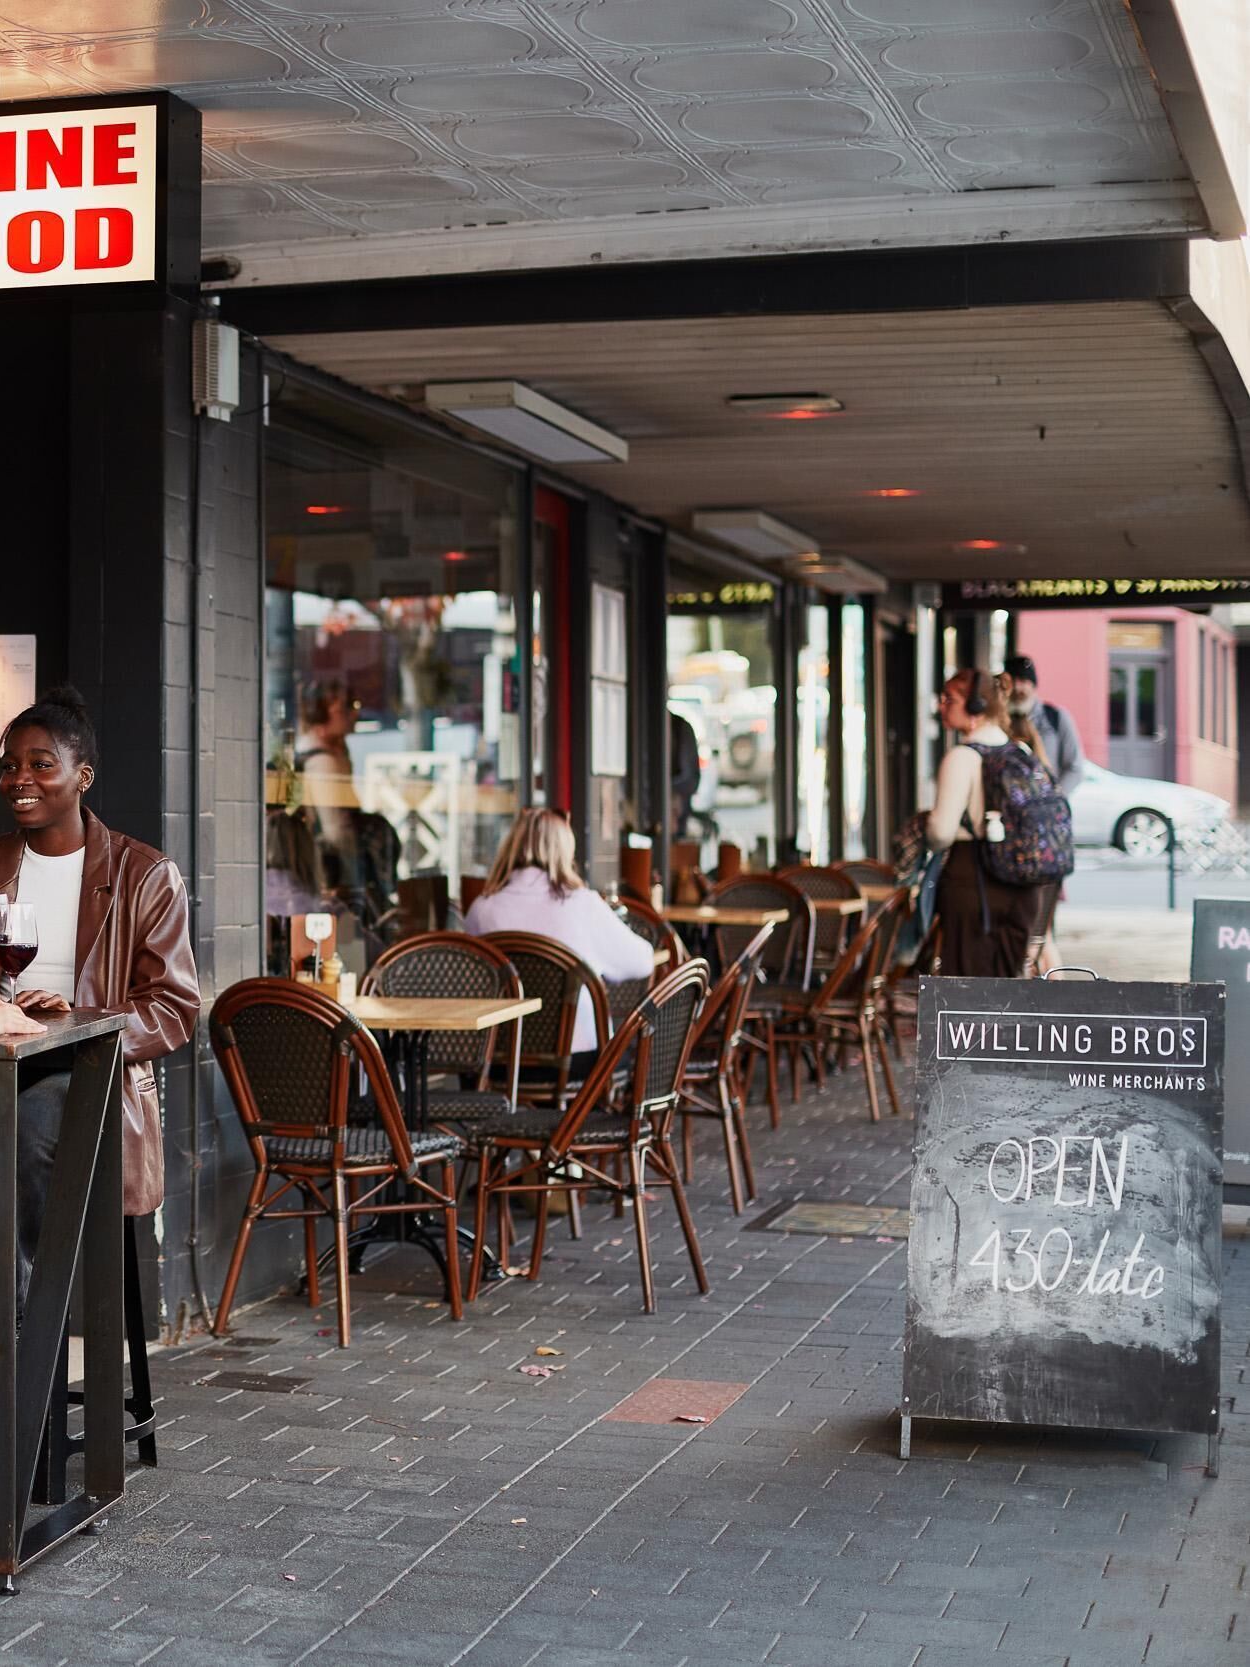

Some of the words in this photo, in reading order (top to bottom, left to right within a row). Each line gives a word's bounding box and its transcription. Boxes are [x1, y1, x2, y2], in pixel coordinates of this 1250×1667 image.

[948, 1021, 1093, 1054] WILLING
[1068, 1073, 1107, 1088] WINE
[1112, 1076, 1207, 1091] MERCHANTS
[987, 1134, 1128, 1211] OPEN
